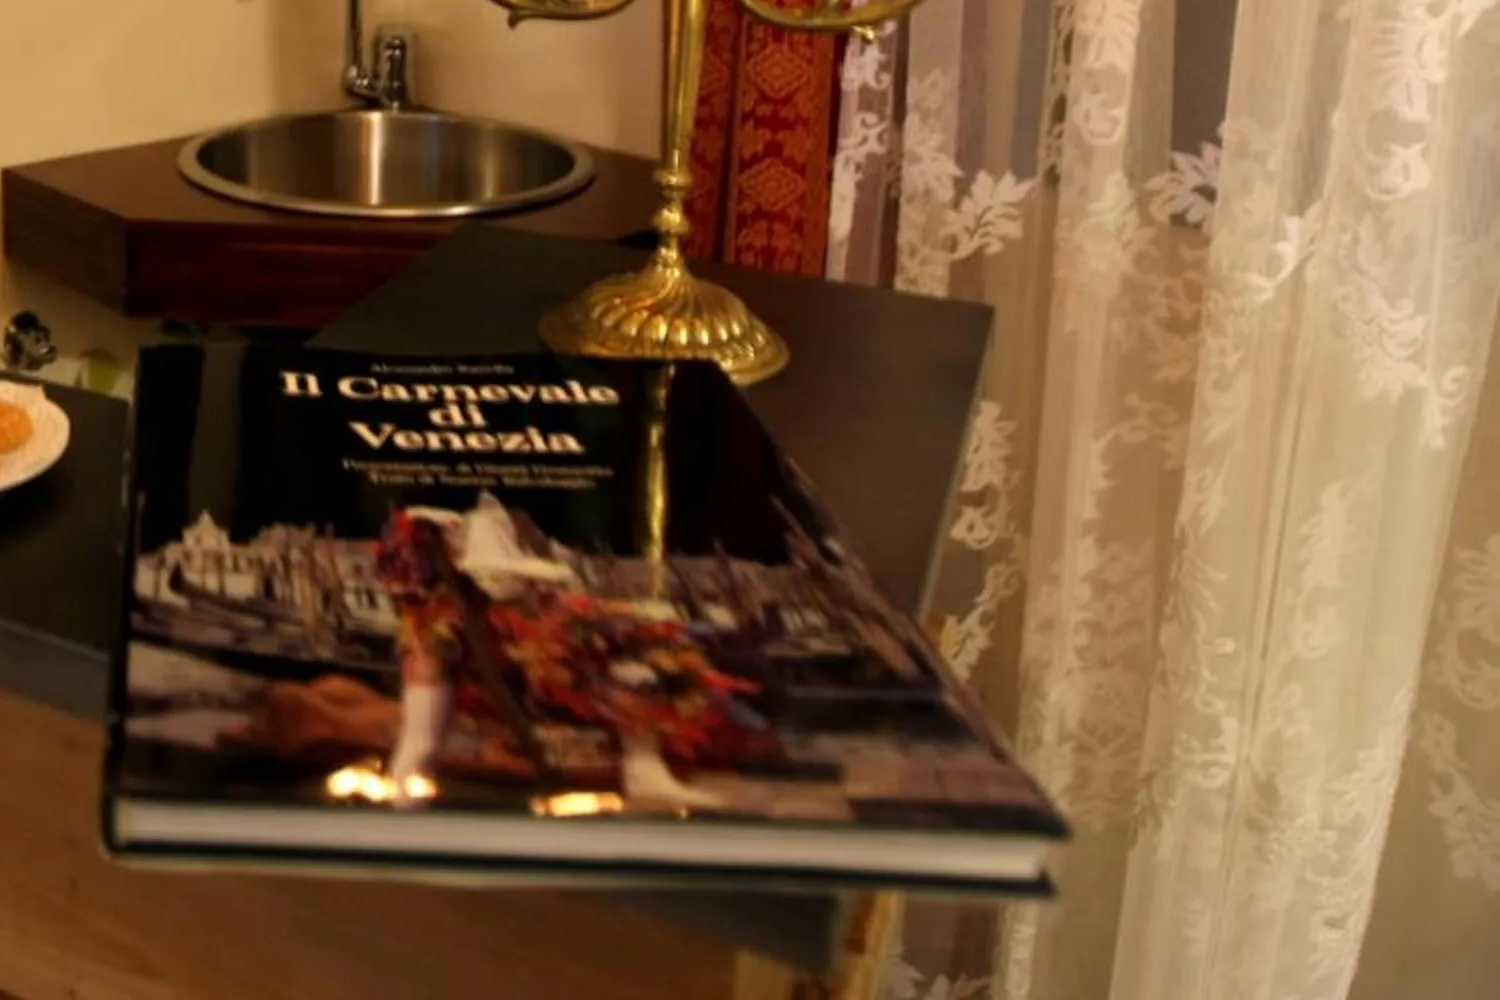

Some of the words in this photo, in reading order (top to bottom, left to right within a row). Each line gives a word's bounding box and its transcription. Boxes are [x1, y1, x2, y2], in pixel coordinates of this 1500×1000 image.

[279, 370, 323, 398] Il
[337, 375, 621, 406] Carnevale
[428, 403, 489, 428] di
[348, 421, 586, 454] Venezia
